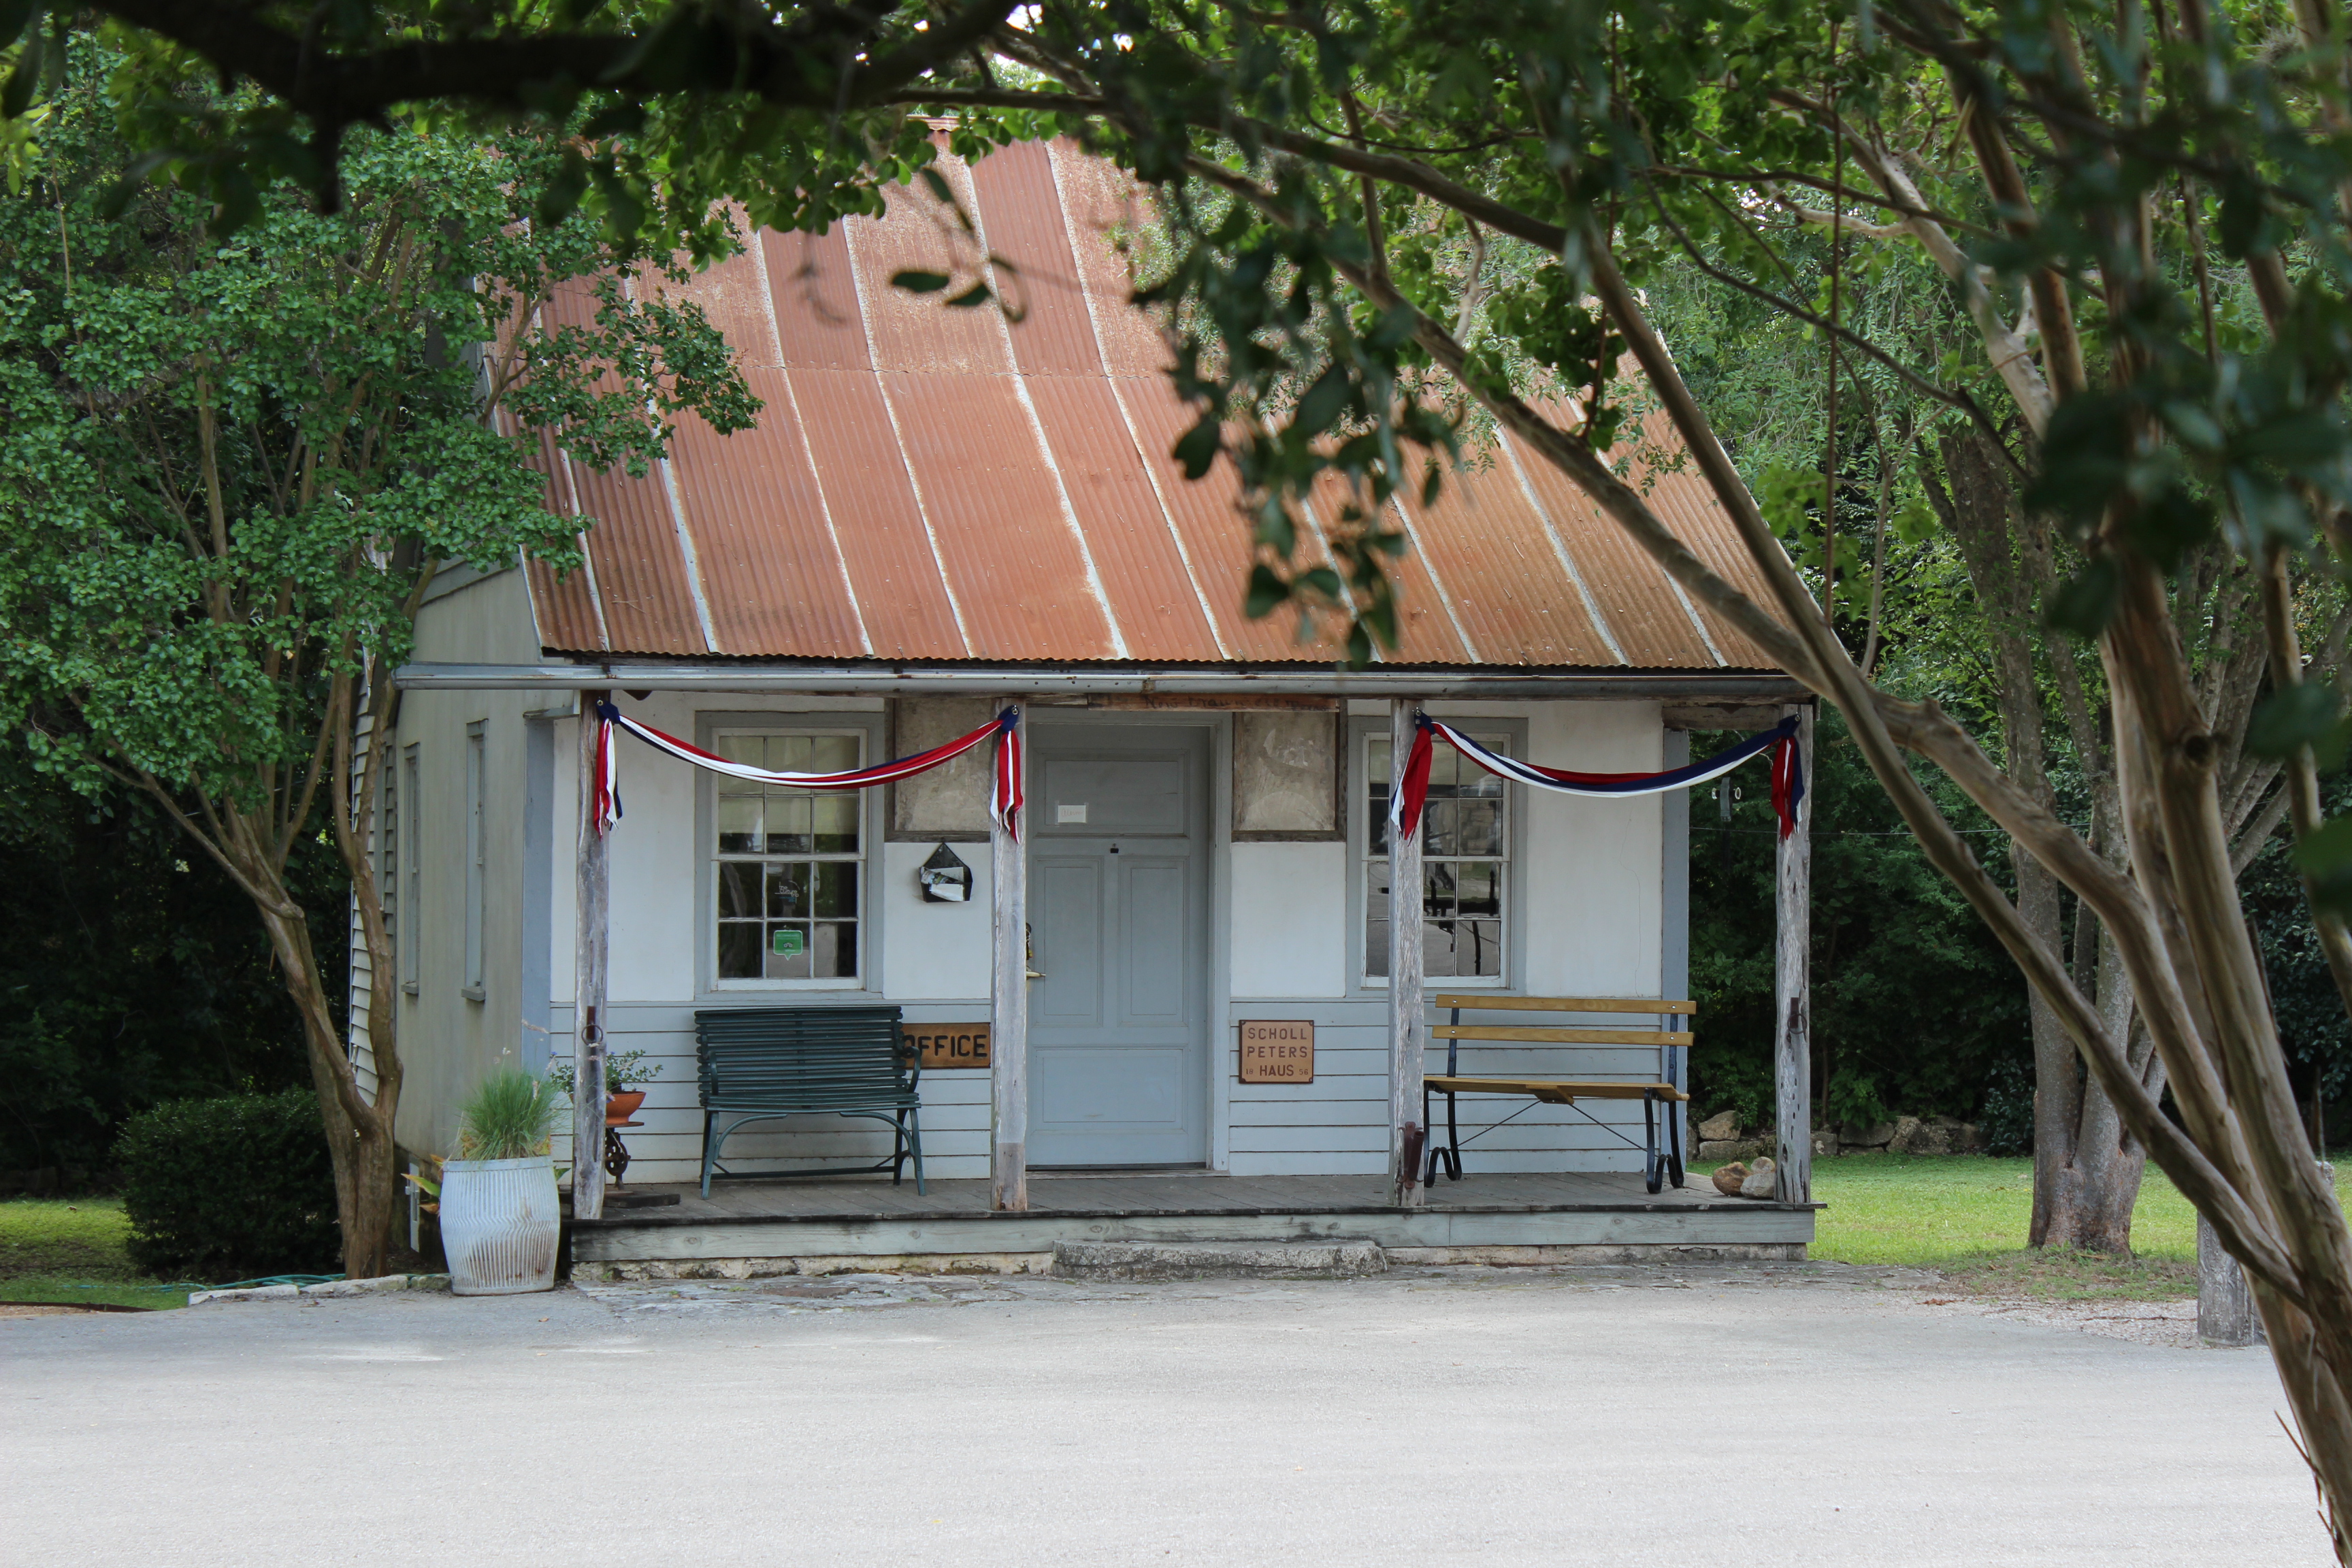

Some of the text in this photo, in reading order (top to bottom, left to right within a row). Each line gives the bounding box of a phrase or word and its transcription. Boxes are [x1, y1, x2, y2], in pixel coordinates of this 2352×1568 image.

[1247, 1028, 1307, 1040] SCHOLL
[902, 1034, 987, 1059] OFFICE
[1247, 1046, 1307, 1058] PETERS
[1260, 1064, 1294, 1076] HAUS
